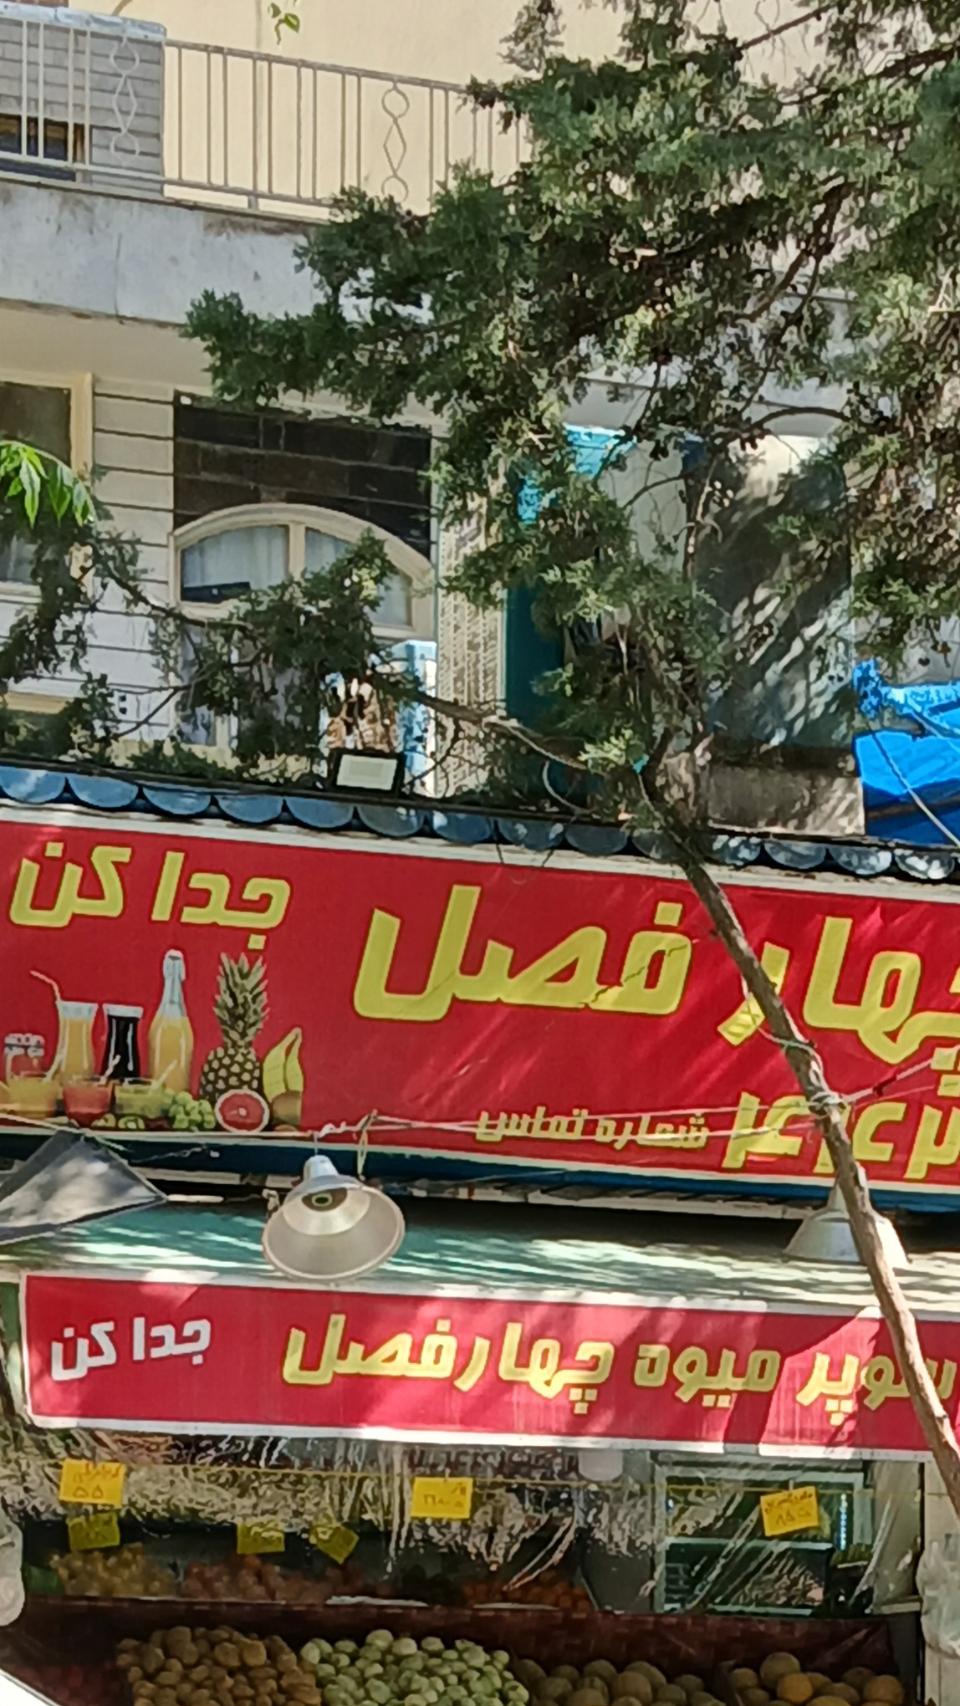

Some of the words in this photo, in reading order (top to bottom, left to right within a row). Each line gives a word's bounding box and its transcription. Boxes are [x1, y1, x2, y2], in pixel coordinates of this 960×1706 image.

[10, 842, 131, 928] کن
[152, 851, 290, 950] جدا
[353, 885, 692, 1021] فصل
[476, 1106, 589, 1142] تماس
[594, 1111, 711, 1150] شماره
[50, 1320, 118, 1383] کن
[132, 1316, 212, 1366] جدا
[634, 1344, 780, 1409] میوه
